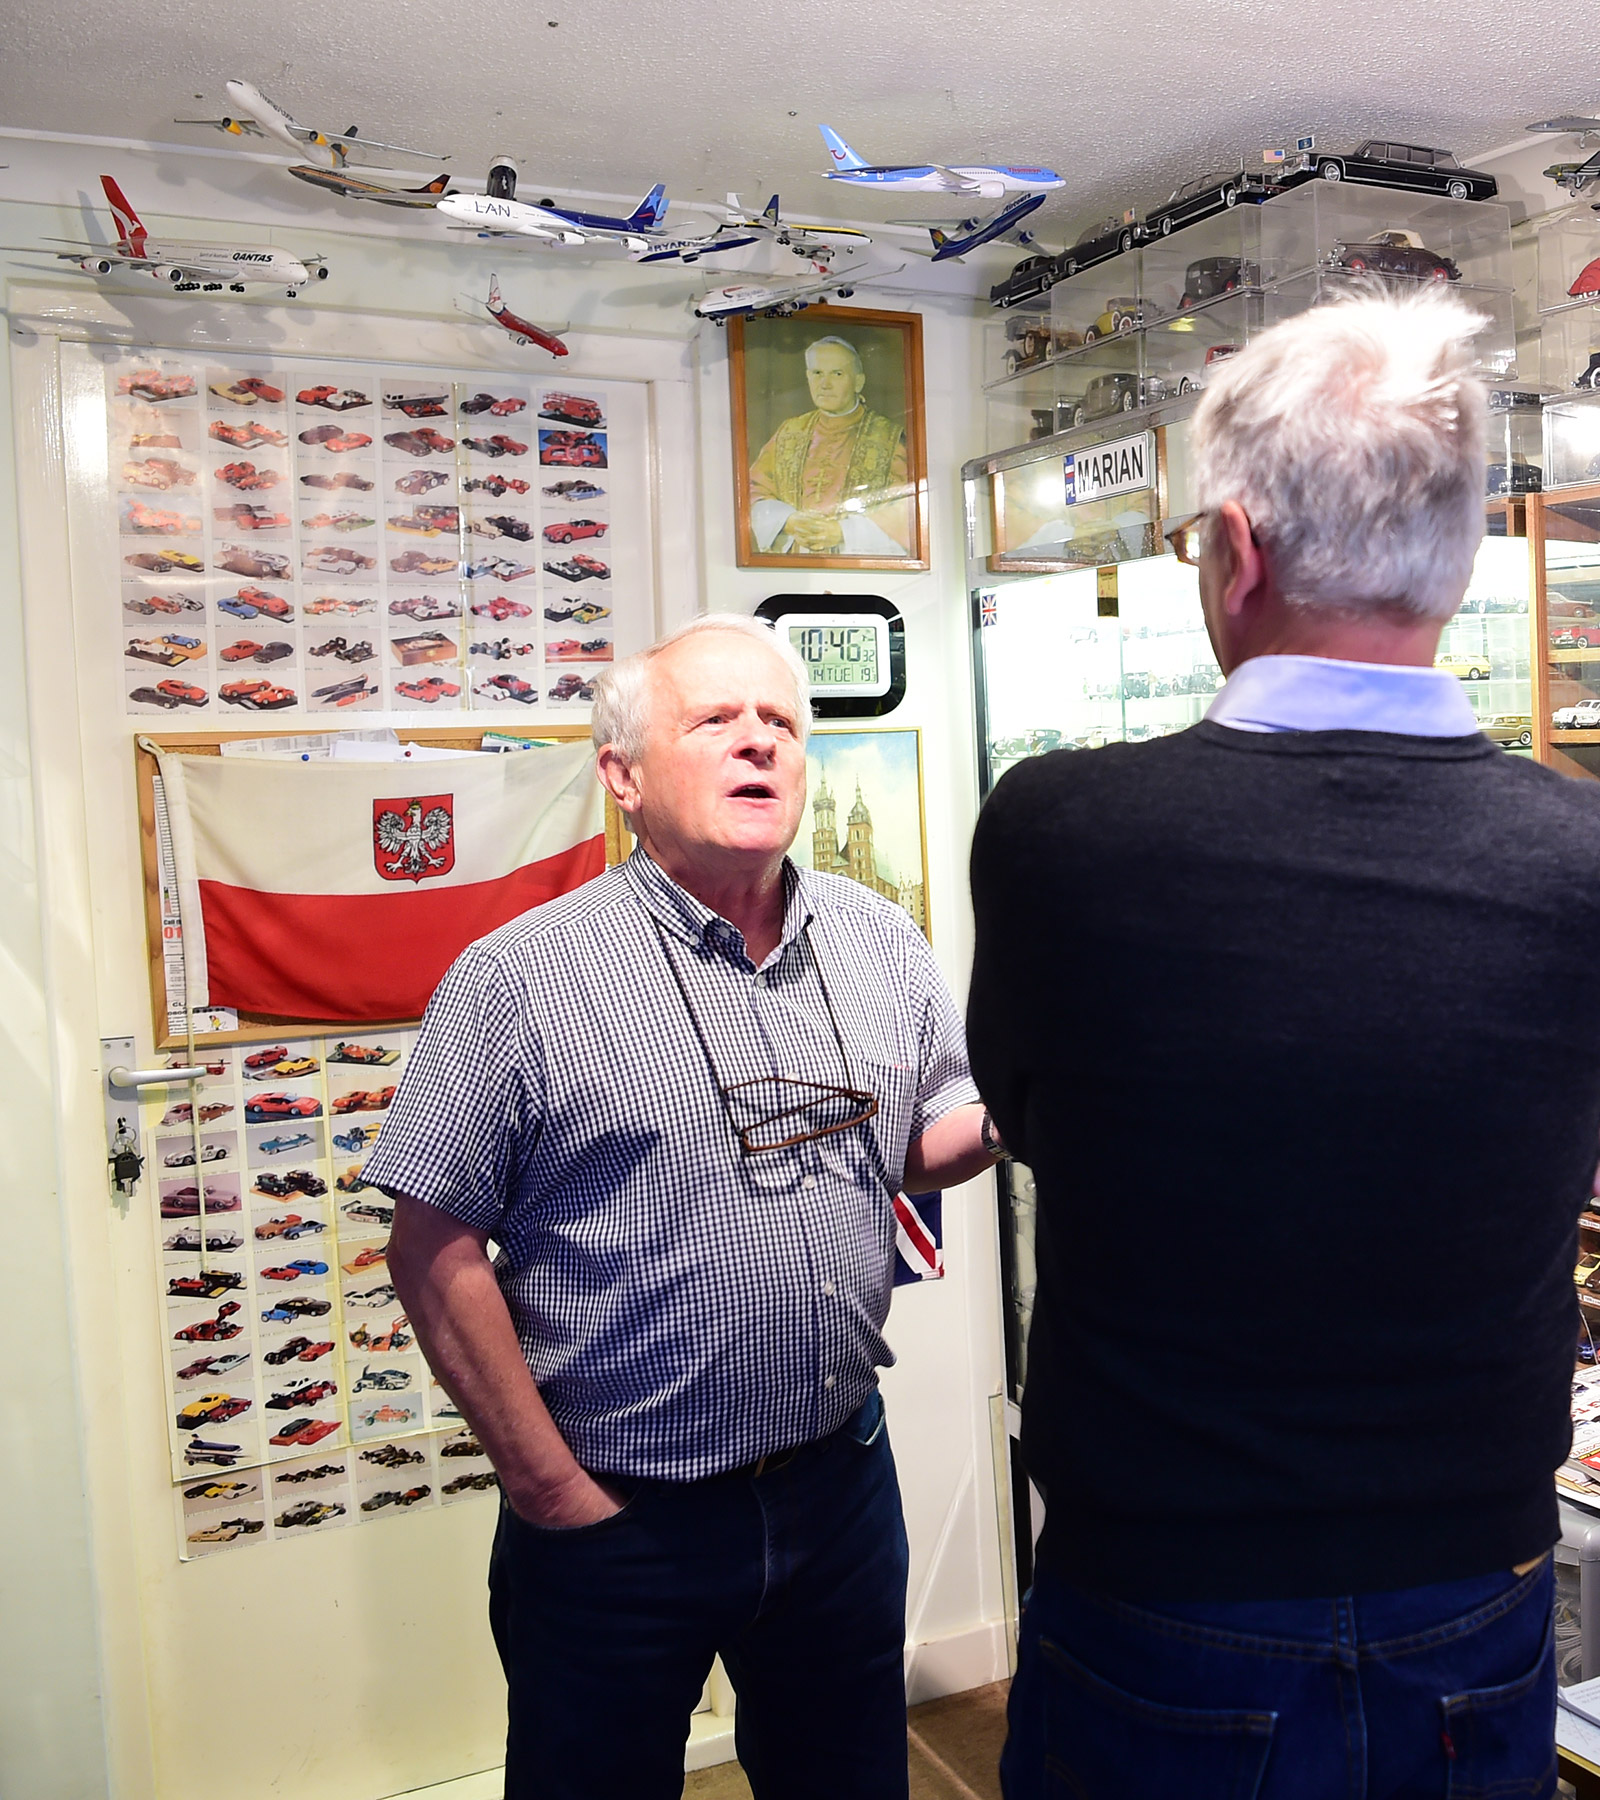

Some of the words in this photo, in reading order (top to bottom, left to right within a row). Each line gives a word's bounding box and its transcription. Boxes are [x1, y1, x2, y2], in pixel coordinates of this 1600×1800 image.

[475, 201, 510, 217] LAN
[232, 252, 274, 262] QANTAS
[1078, 444, 1143, 493] MARIAN
[1066, 483, 1075, 498] PL
[801, 629, 861, 662] 10:46
[863, 649, 875, 662] 32
[827, 667, 851, 682] TUE
